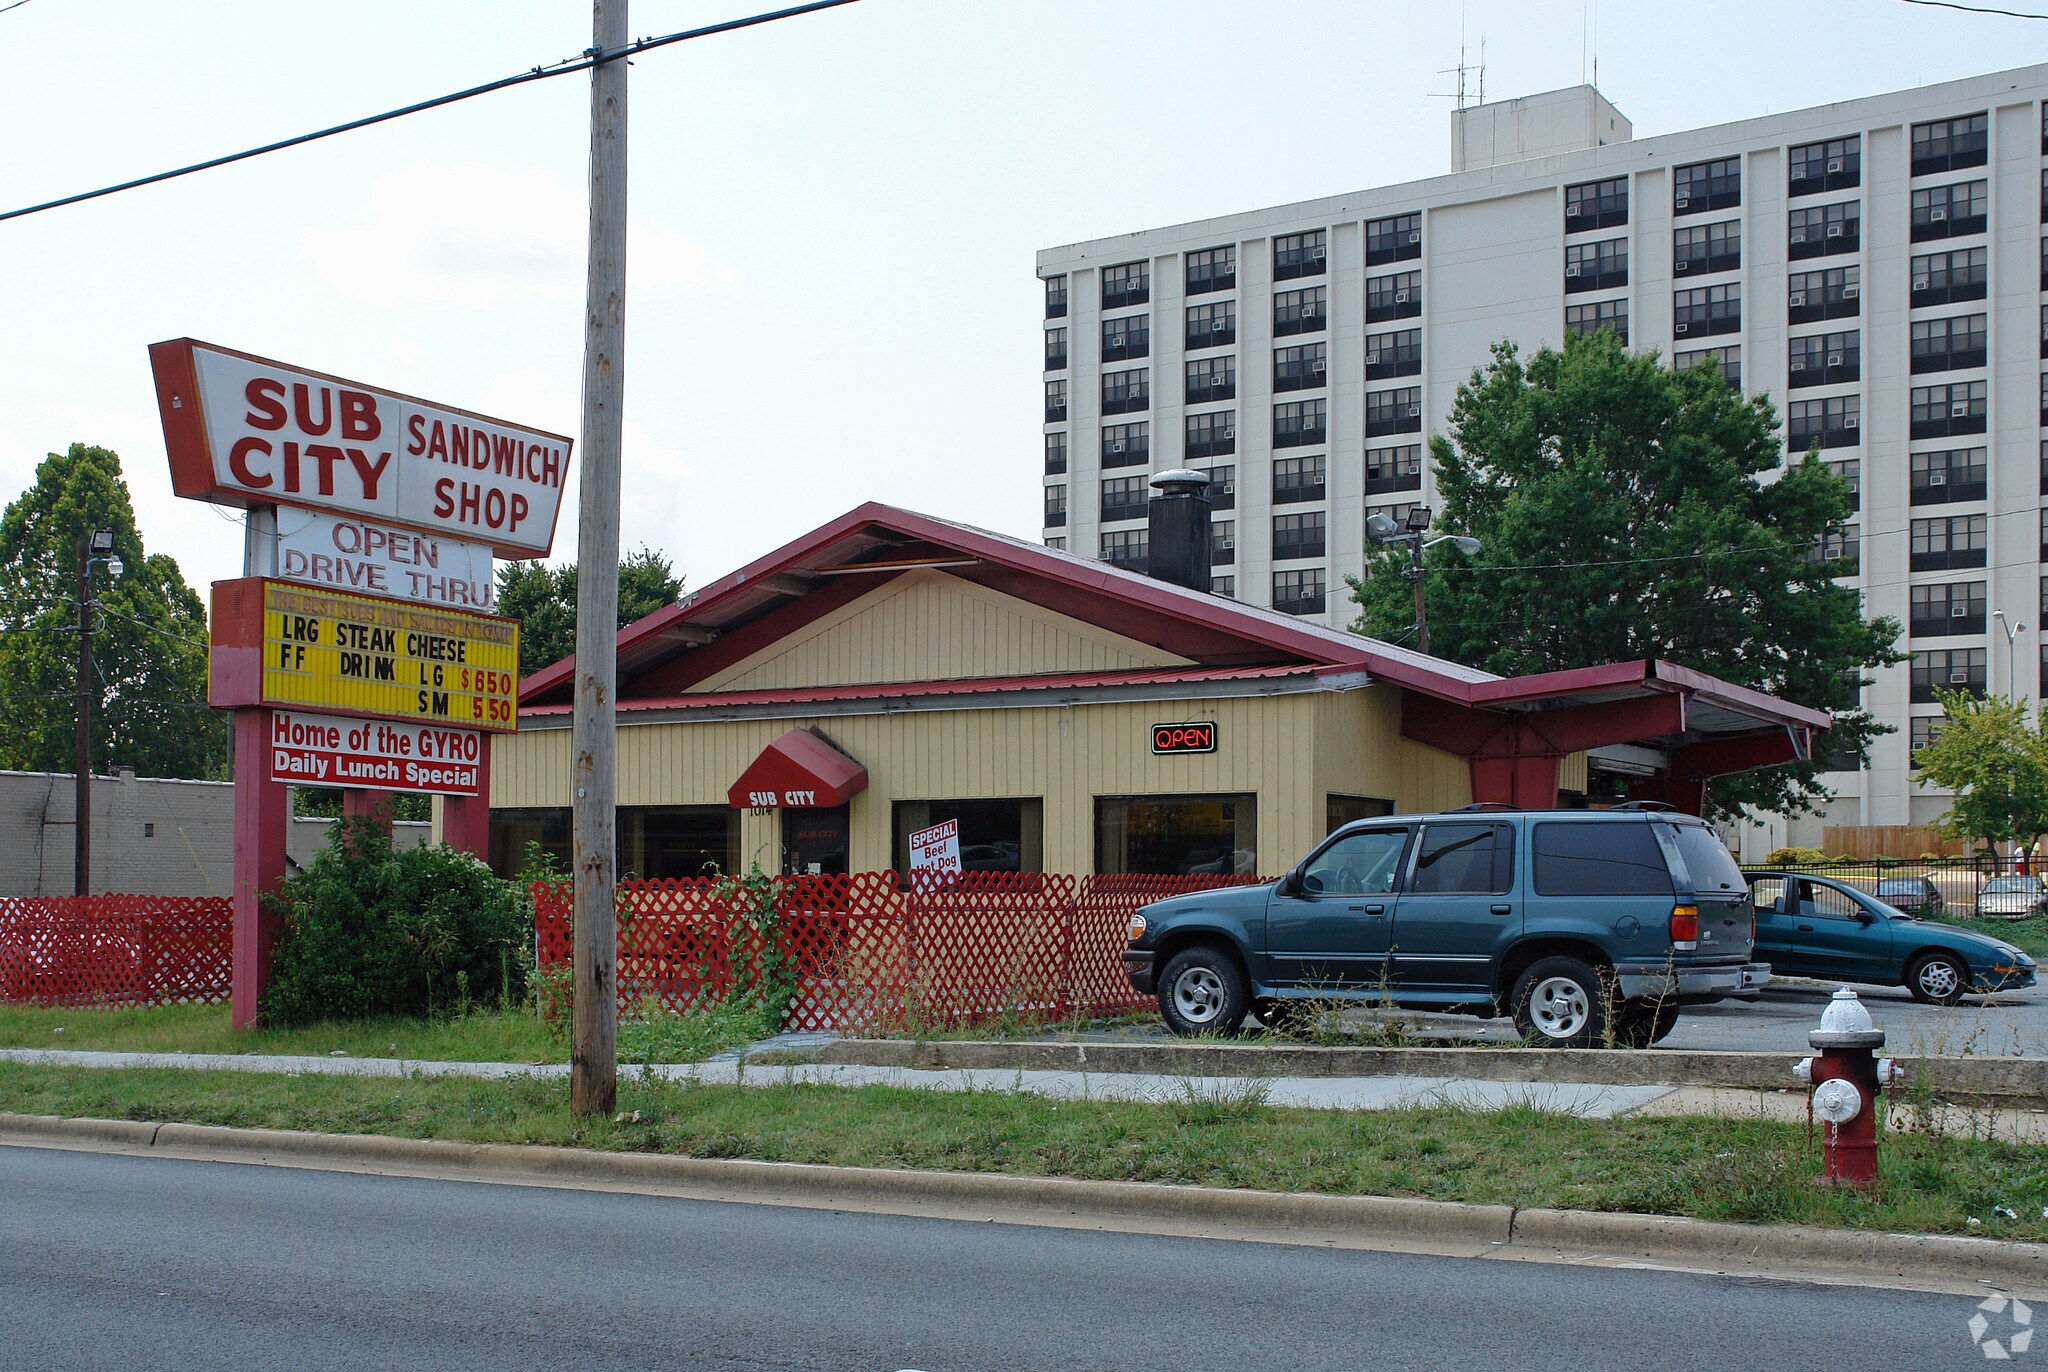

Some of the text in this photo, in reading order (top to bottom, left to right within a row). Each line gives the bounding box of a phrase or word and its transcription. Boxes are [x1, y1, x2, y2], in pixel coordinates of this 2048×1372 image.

[245, 377, 382, 441] SUB
[229, 436, 391, 500] CITY
[407, 413, 560, 488] SANDWICH
[433, 477, 529, 533] SHOP
[332, 522, 438, 569] OPEN
[285, 548, 491, 608] DRIVE THRU
[283, 615, 466, 663] LRG STEAK CHEESE
[342, 602, 375, 621] SUBS
[379, 608, 405, 626] AND
[410, 613, 457, 635] SALADS
[340, 652, 395, 681] DRINK
[275, 713, 478, 762] Home of the GYRO
[1156, 729, 1210, 748] OPEN
[275, 751, 477, 787] Daily Lunch Special
[749, 790, 815, 807] SUB CITY
[912, 823, 956, 848] SPECIAL
[924, 840, 947, 859] Beef
[938, 855, 957, 870] Dog
